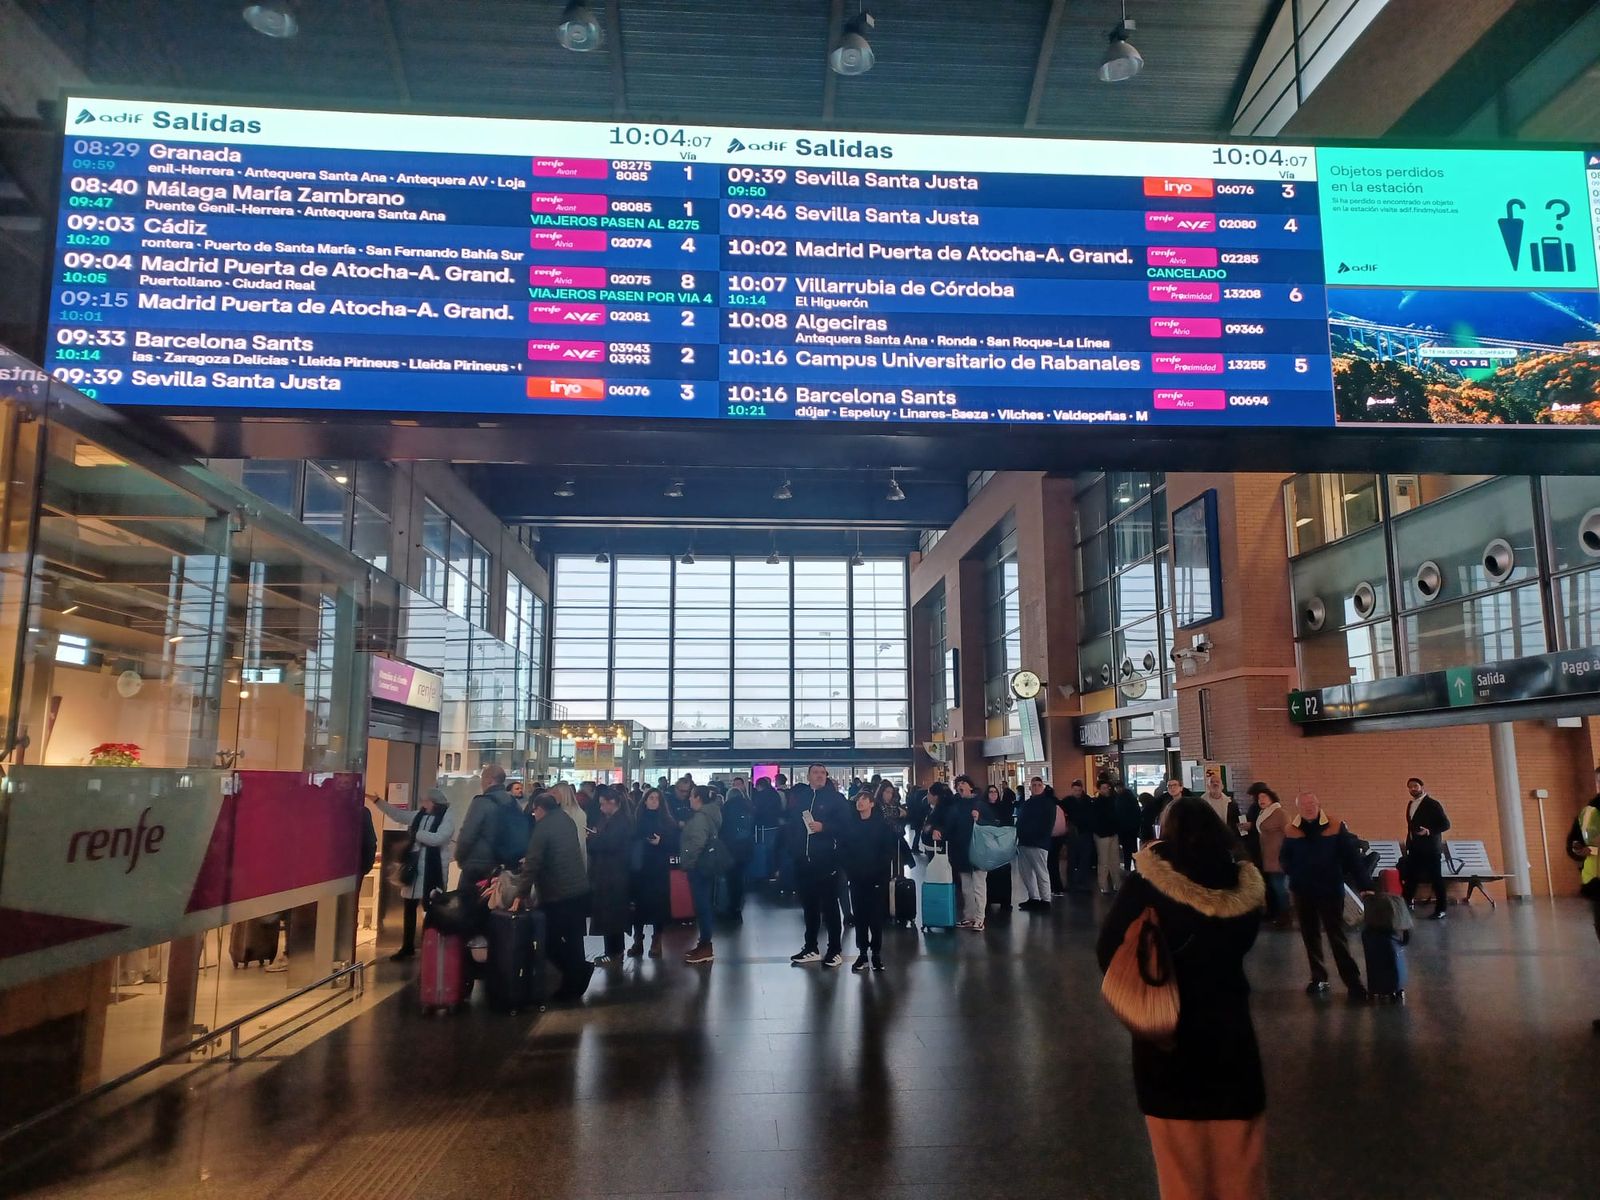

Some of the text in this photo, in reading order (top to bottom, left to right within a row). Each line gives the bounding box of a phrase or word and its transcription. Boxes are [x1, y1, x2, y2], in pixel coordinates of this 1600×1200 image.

[99, 113, 143, 123] adif
[153, 111, 261, 133] Salidas
[610, 127, 711, 147] 10:04:07
[74, 140, 140, 157] 08:29
[149, 144, 241, 162] Granada
[748, 141, 786, 151] adif
[796, 139, 893, 159] Salidas
[680, 152, 696, 160] Vía
[1213, 148, 1307, 167] 10:04:07
[612, 160, 652, 171] 08275
[1330, 165, 1444, 179] Objetos perdidos
[148, 163, 526, 190] enil-Herrera Antequera Santa Ana Antequera AV Loja
[616, 171, 648, 181] 8085
[728, 168, 786, 184] 09:39
[795, 170, 978, 190] Sevilla Santa Justa
[1279, 171, 1294, 179] Vía
[71, 177, 138, 195] 08:40
[147, 180, 405, 205] Málaga María Zambrano
[728, 186, 766, 197] 09:50
[1164, 180, 1192, 195] iryo
[1217, 185, 1254, 194] 06076
[1331, 181, 1423, 193] en la estación
[69, 196, 113, 208] 09:47
[611, 202, 652, 212] 08085
[145, 200, 446, 221] Puente Genil-Herrera Antequera Santa Ana
[728, 203, 787, 220] 09:46
[67, 215, 135, 232] 09:03
[144, 218, 207, 235] Cádiz
[530, 214, 699, 230] VIAJEROS PASEN AL 8275
[1177, 221, 1211, 230] AVE
[1219, 219, 1257, 229] 02080
[66, 234, 110, 245] 10:20
[611, 238, 652, 248] 02074
[681, 238, 696, 253] 4
[142, 238, 525, 261] rontera Puerto Santa María San Fernando Bahía Sur
[729, 239, 787, 256] 10:02
[64, 252, 133, 270] 09:04
[1221, 254, 1259, 264] 02285
[141, 255, 515, 283] Madrid Puerta de Atocha-A. Grand.
[534, 268, 562, 277] renfe
[1147, 268, 1227, 279] CANCELADO
[1351, 264, 1378, 272] adif
[63, 272, 107, 283] 10:05
[140, 275, 316, 291] Puertollano Ciudad Real
[610, 274, 651, 285] 02075
[729, 275, 787, 292] 10:07
[795, 277, 1014, 297] Villarrubia de Córdoba
[1152, 284, 1178, 293] renfe
[1224, 289, 1261, 299] 13208
[61, 291, 128, 307] 09:15
[528, 288, 712, 303] VIAJEROS PASEN POR VIA 4
[728, 294, 766, 305] 10:14
[1171, 292, 1212, 300] Proximidad
[1289, 288, 1302, 302] 6
[796, 296, 868, 310] El Higuerón
[59, 310, 103, 322] 10:01
[564, 312, 601, 322] AVE
[610, 311, 651, 322] 02081
[729, 312, 787, 329] 10:08
[795, 314, 887, 333] Algeciras
[1225, 324, 1264, 334] 09366
[57, 329, 126, 346] 09:33
[135, 331, 313, 351] Barcelona Sants
[795, 333, 1110, 349] Antequera Santa Ana Ronda San Roque-La Línea
[56, 349, 100, 360] 10:14
[609, 343, 650, 353] 03943
[164, 352, 509, 372] Zaragoza Delicias Lleida Pirineus Lleida Pirineus
[609, 353, 650, 364] 03993
[728, 349, 787, 365] 10:16
[796, 351, 1140, 371] Campus Universitario de Rabanales
[1228, 360, 1266, 370] 13255
[1295, 358, 1307, 373] 5
[728, 386, 788, 402] 10:16
[1229, 396, 1269, 406] 00694
[728, 405, 766, 416] 10:21
[839, 407, 1127, 423] Espeluy Linares-Baeza Vilches Valdepeñas
[1561, 661, 1590, 676] Pago
[1477, 672, 1505, 686] Salida
[417, 682, 437, 702] renfe
[1305, 697, 1318, 715] P2
[67, 806, 164, 874] renfe
